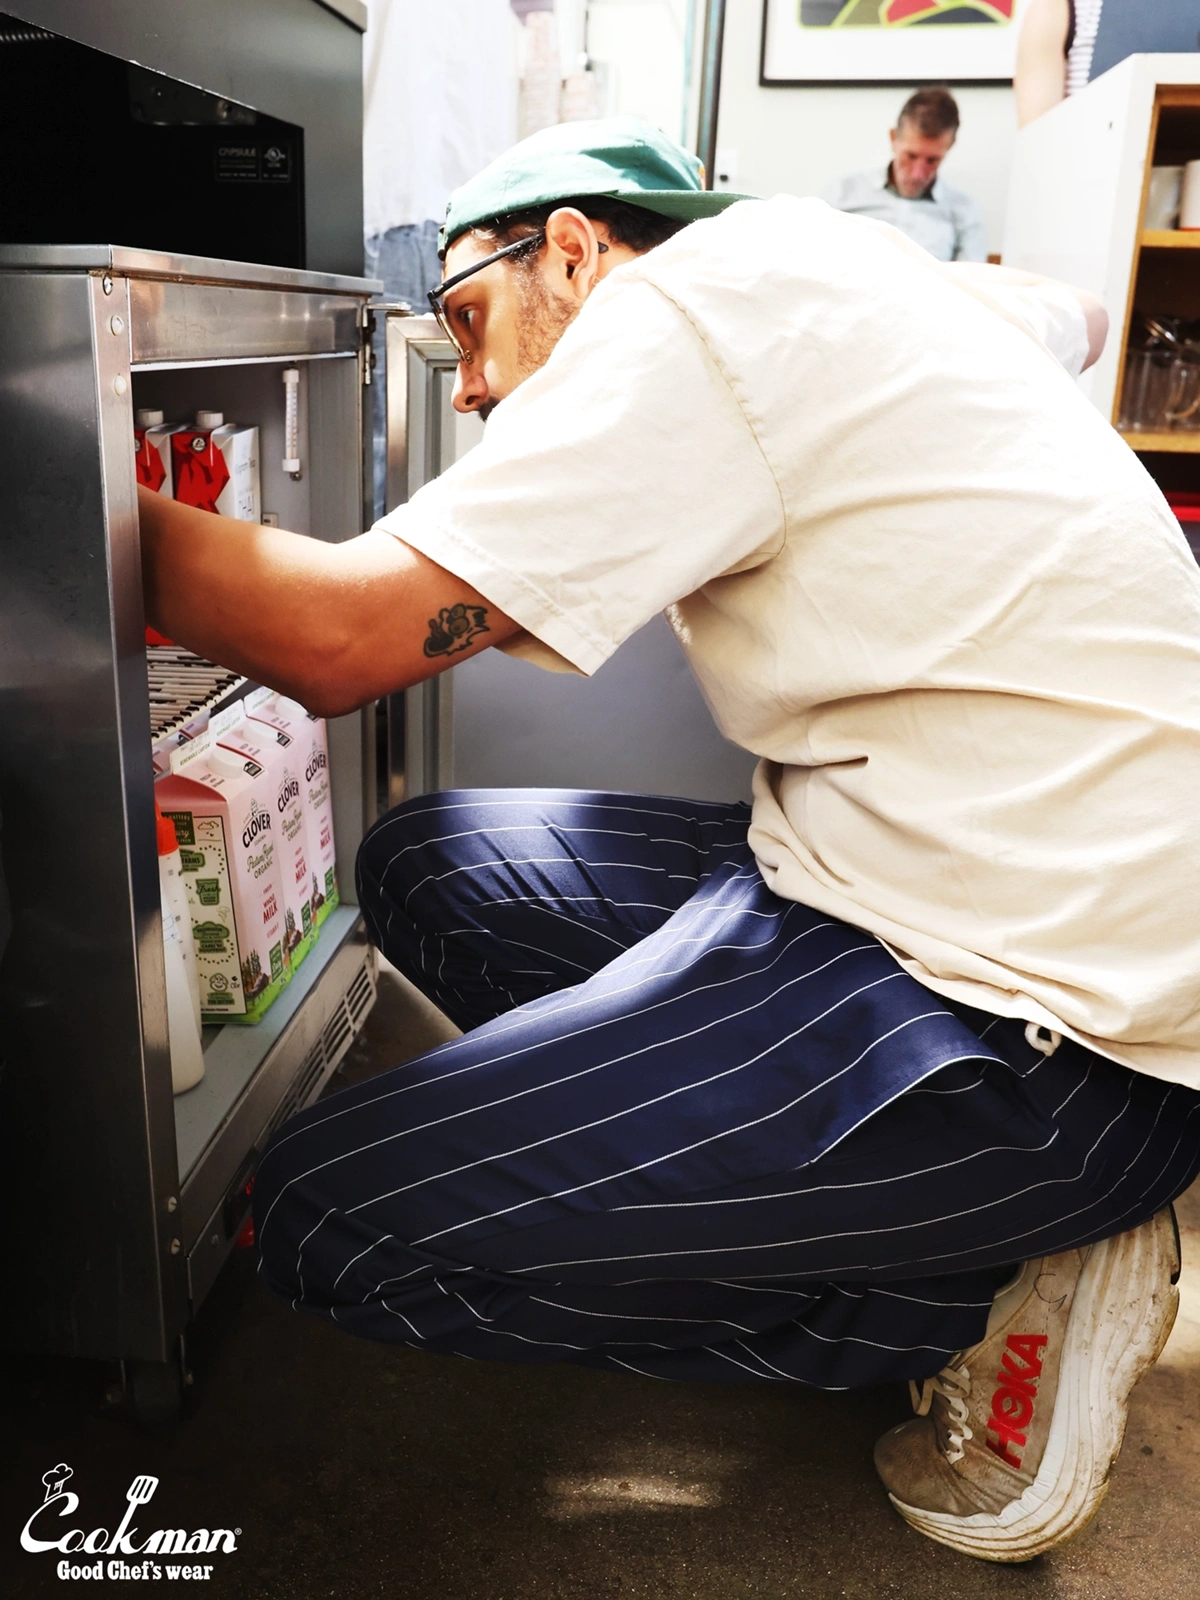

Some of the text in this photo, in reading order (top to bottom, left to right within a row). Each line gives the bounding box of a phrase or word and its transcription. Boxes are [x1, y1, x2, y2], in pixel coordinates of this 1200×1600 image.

[305, 753, 327, 782] CLOVER
[277, 780, 299, 813] CLOVER
[242, 813, 272, 848] CLOVER
[263, 899, 279, 925] MILK
[985, 1334, 1049, 1470] HOKA
